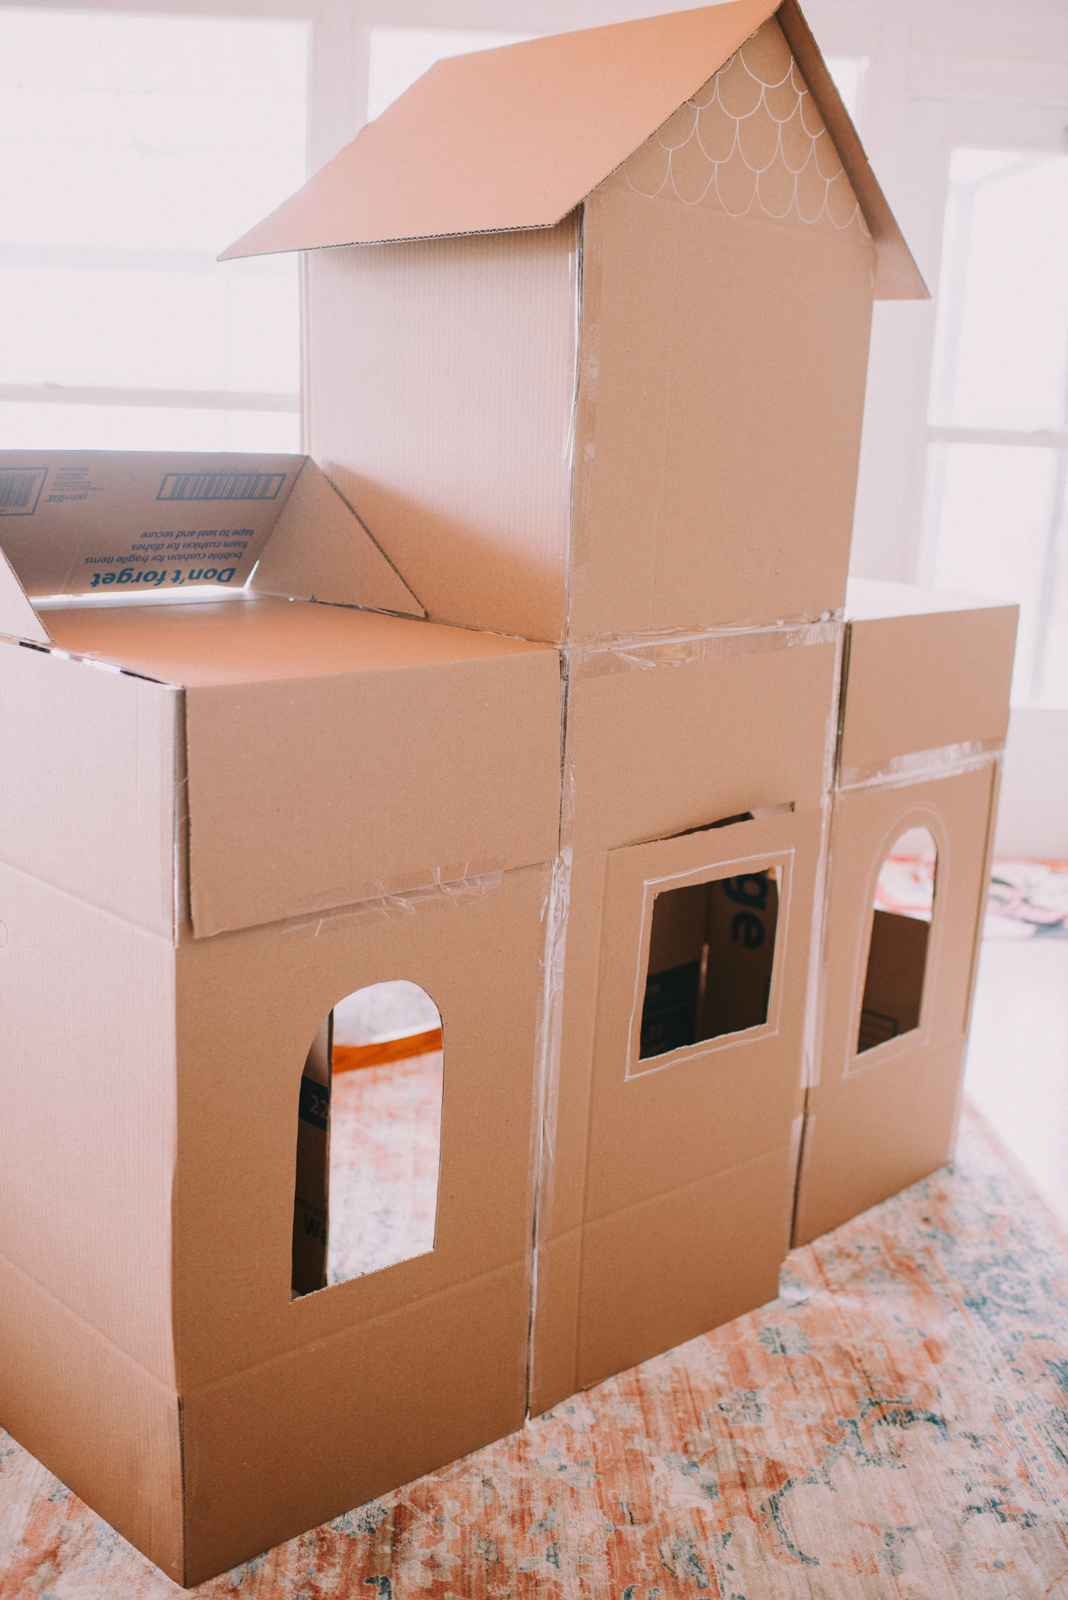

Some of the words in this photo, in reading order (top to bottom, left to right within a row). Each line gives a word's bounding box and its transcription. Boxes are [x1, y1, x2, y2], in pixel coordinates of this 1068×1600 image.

[175, 530, 196, 539] and
[197, 530, 217, 538] seal
[219, 529, 230, 537] to
[231, 528, 254, 536] tape
[131, 542, 165, 552] dishes
[166, 542, 180, 551] for
[182, 542, 221, 550] cushion
[223, 541, 248, 549] foam
[84, 556, 114, 564] items
[116, 554, 149, 564] fragile
[150, 554, 165, 563] for
[167, 553, 206, 561] cushion
[208, 552, 243, 560] bubble
[90, 567, 167, 587] forget
